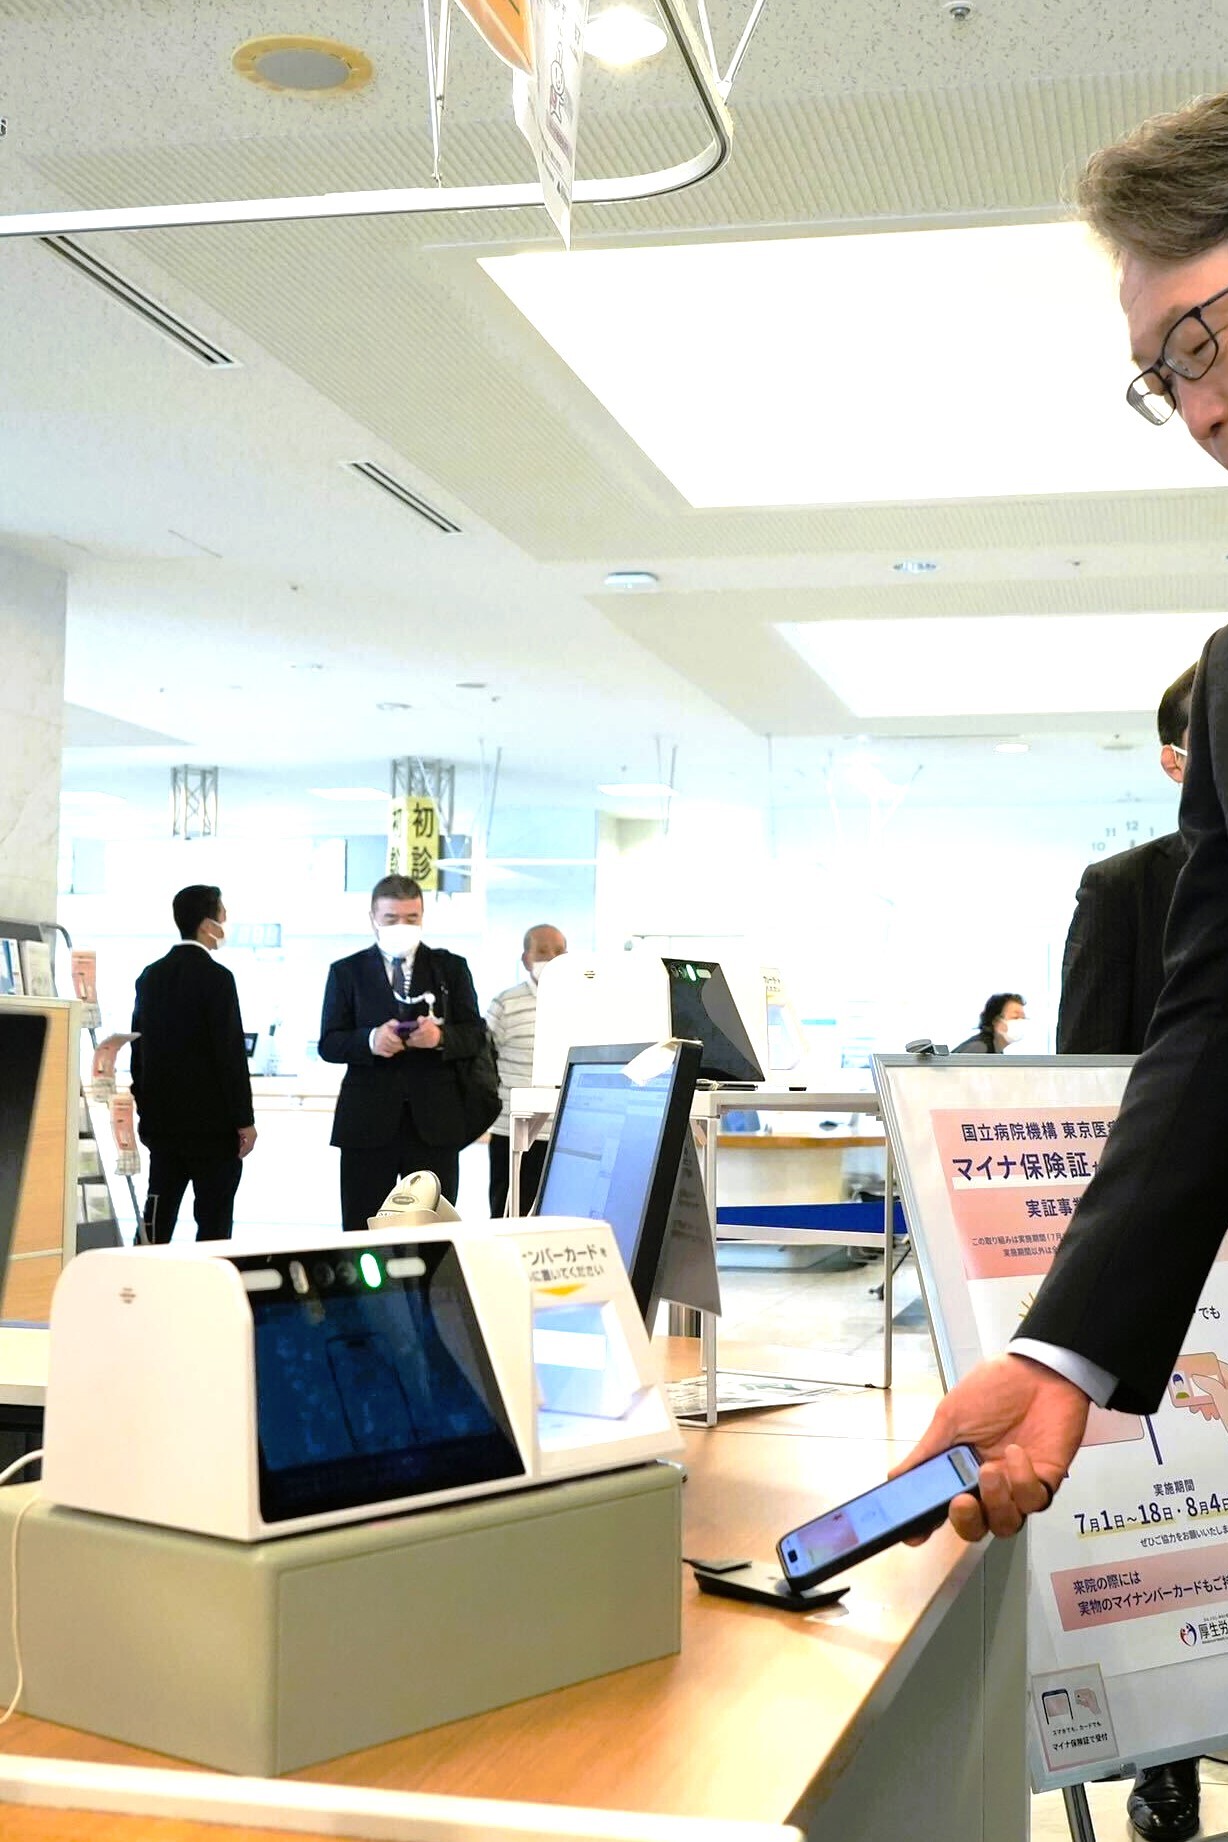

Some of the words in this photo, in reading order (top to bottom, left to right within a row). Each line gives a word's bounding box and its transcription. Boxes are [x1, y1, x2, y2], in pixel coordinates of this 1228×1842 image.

[411, 802, 435, 881] 初診
[962, 1122, 1058, 1142] 国立病院機構
[972, 1233, 1064, 1246] この取り組みは実施期間(7月
[529, 1264, 605, 1282] に置いてください
[1196, 1305, 1221, 1320] でも
[1153, 1478, 1195, 1497] 実施期間
[1073, 1571, 1141, 1595] 来院の際には
